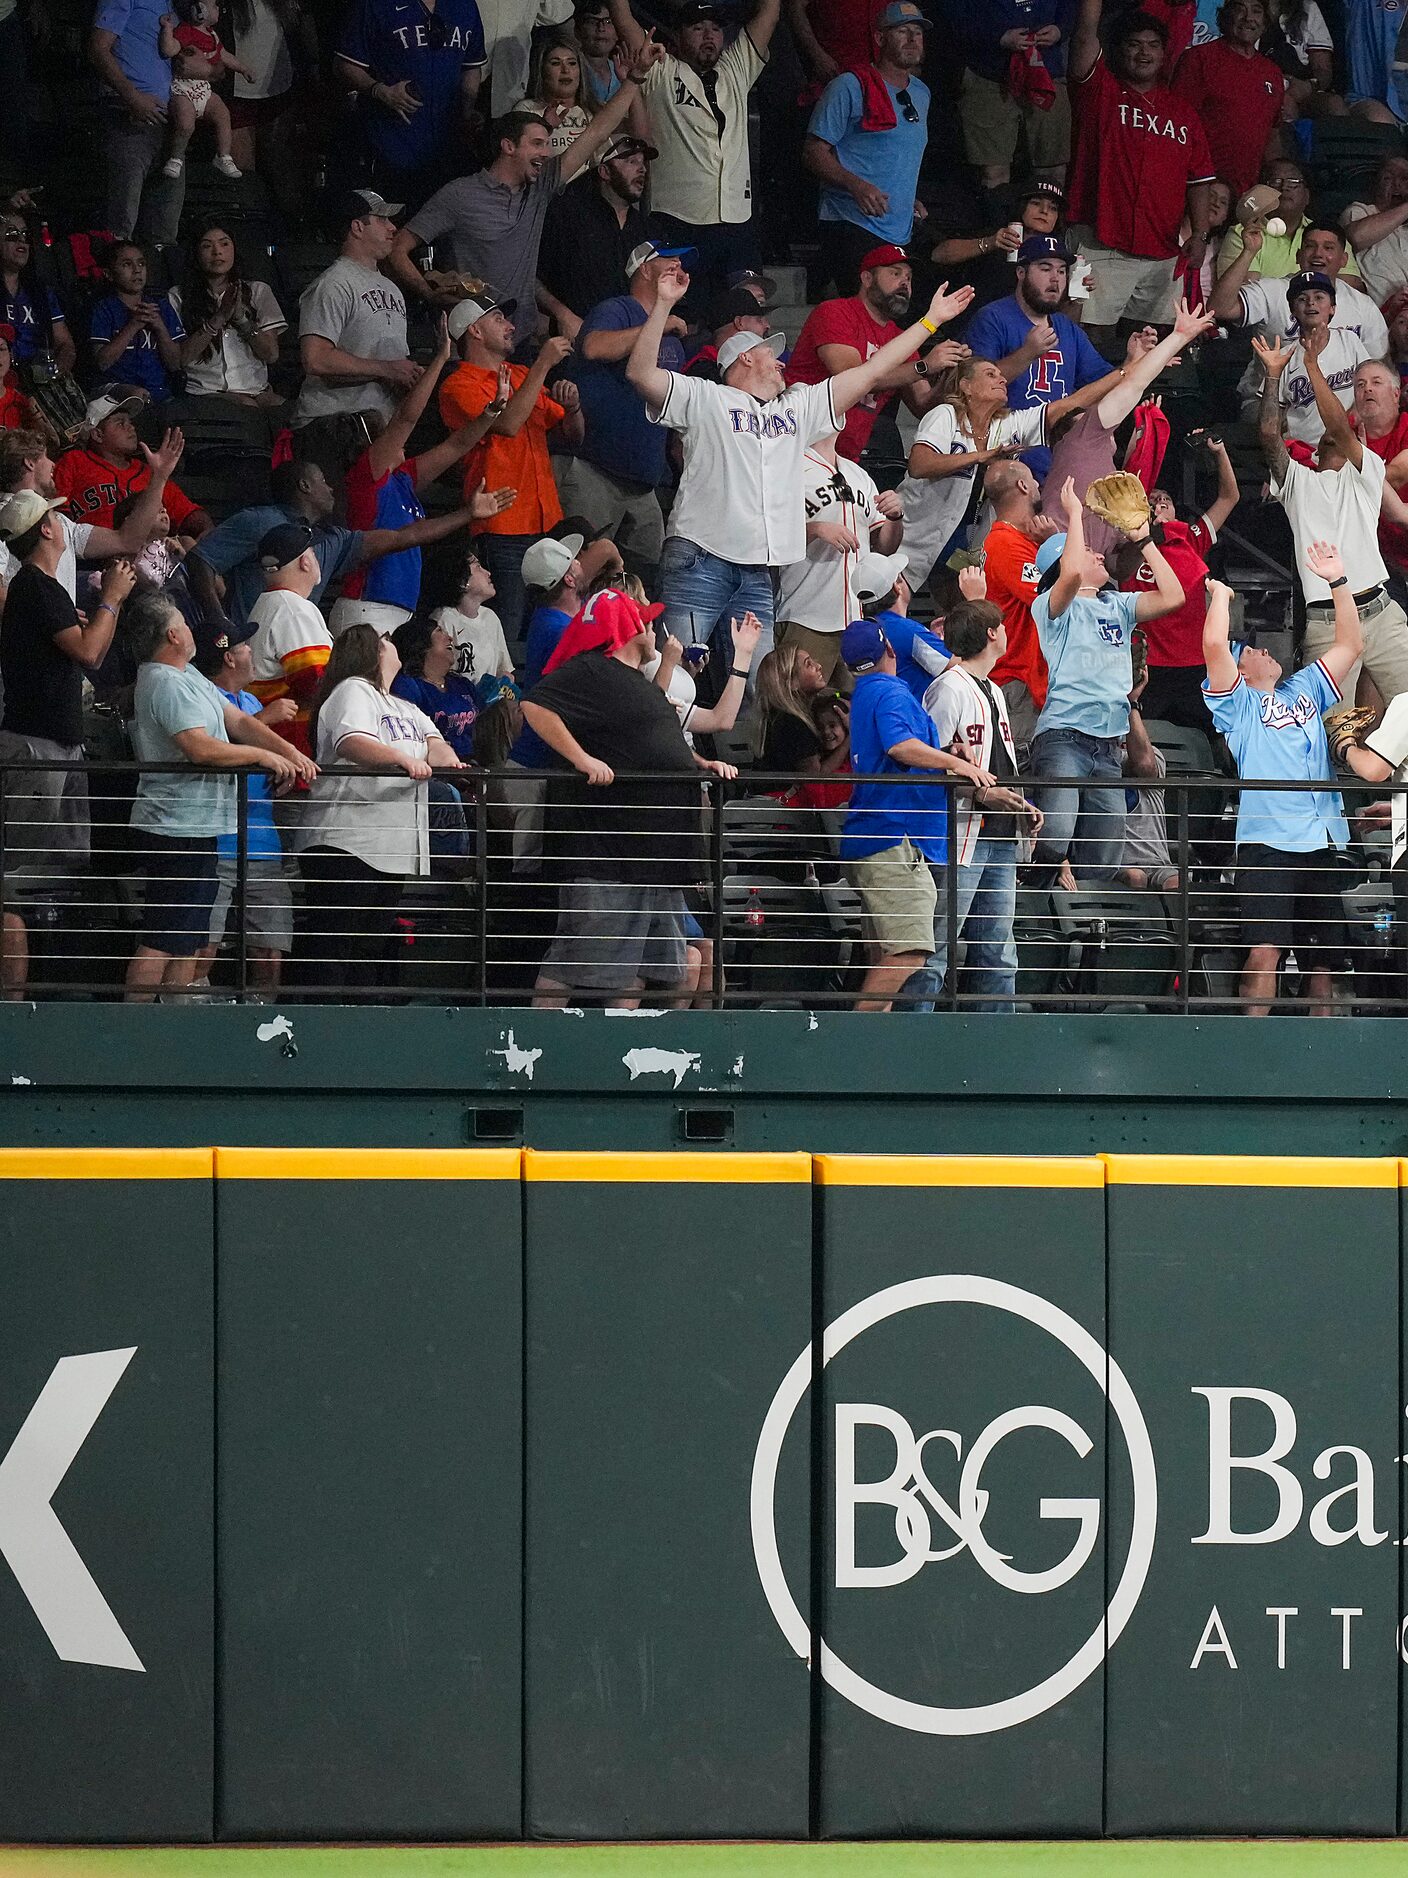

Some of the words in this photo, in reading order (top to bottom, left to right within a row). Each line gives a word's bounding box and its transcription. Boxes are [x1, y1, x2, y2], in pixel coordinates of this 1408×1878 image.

[393, 25, 473, 51] TEAS
[1118, 104, 1189, 145] TEXAS
[1045, 237, 1059, 251] T
[1301, 271, 1315, 282] T
[361, 288, 406, 318] TEXAS
[729, 407, 798, 441] TEXAS
